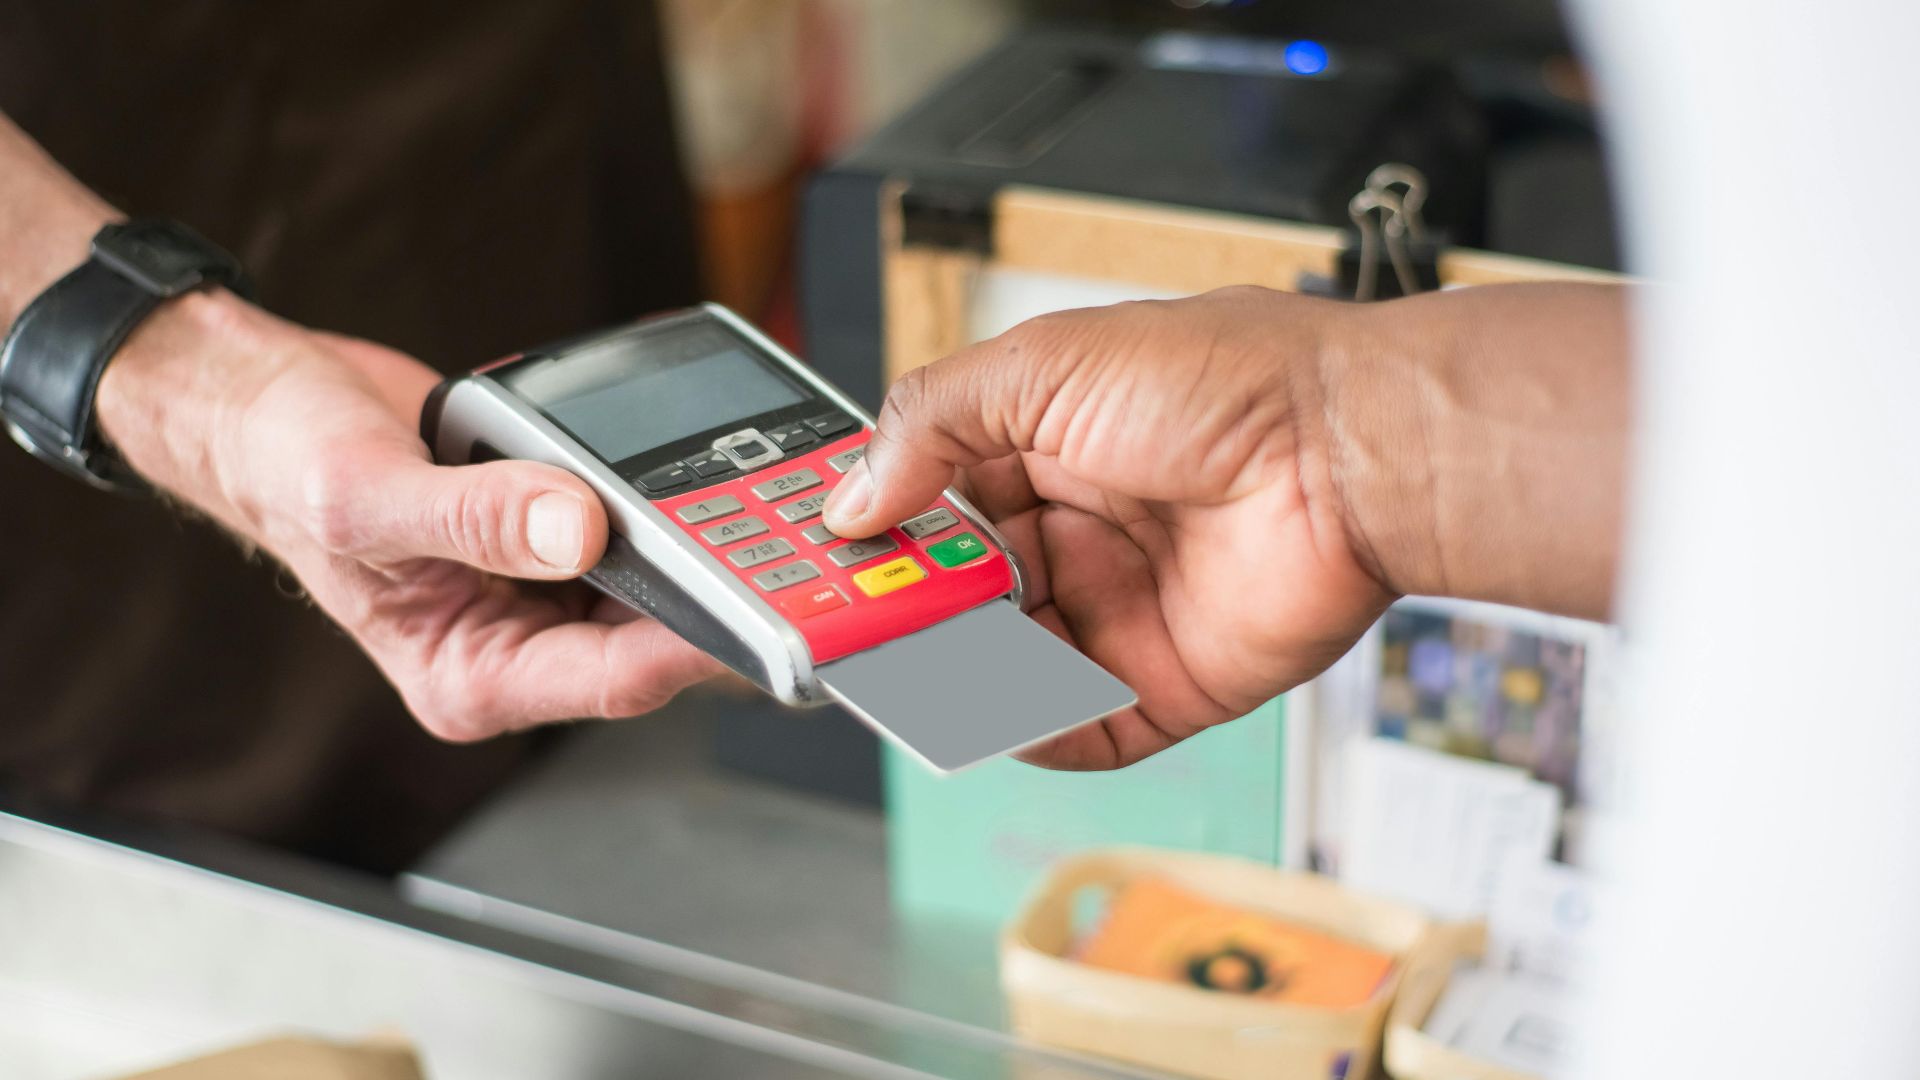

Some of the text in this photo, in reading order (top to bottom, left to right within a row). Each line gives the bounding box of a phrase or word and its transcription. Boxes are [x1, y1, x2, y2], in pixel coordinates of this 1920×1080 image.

[774, 480, 789, 490] 2
[697, 504, 711, 513] 1
[798, 500, 814, 511] 5
[721, 525, 735, 536] 4
[957, 539, 976, 549] OK
[744, 548, 757, 560] 7
